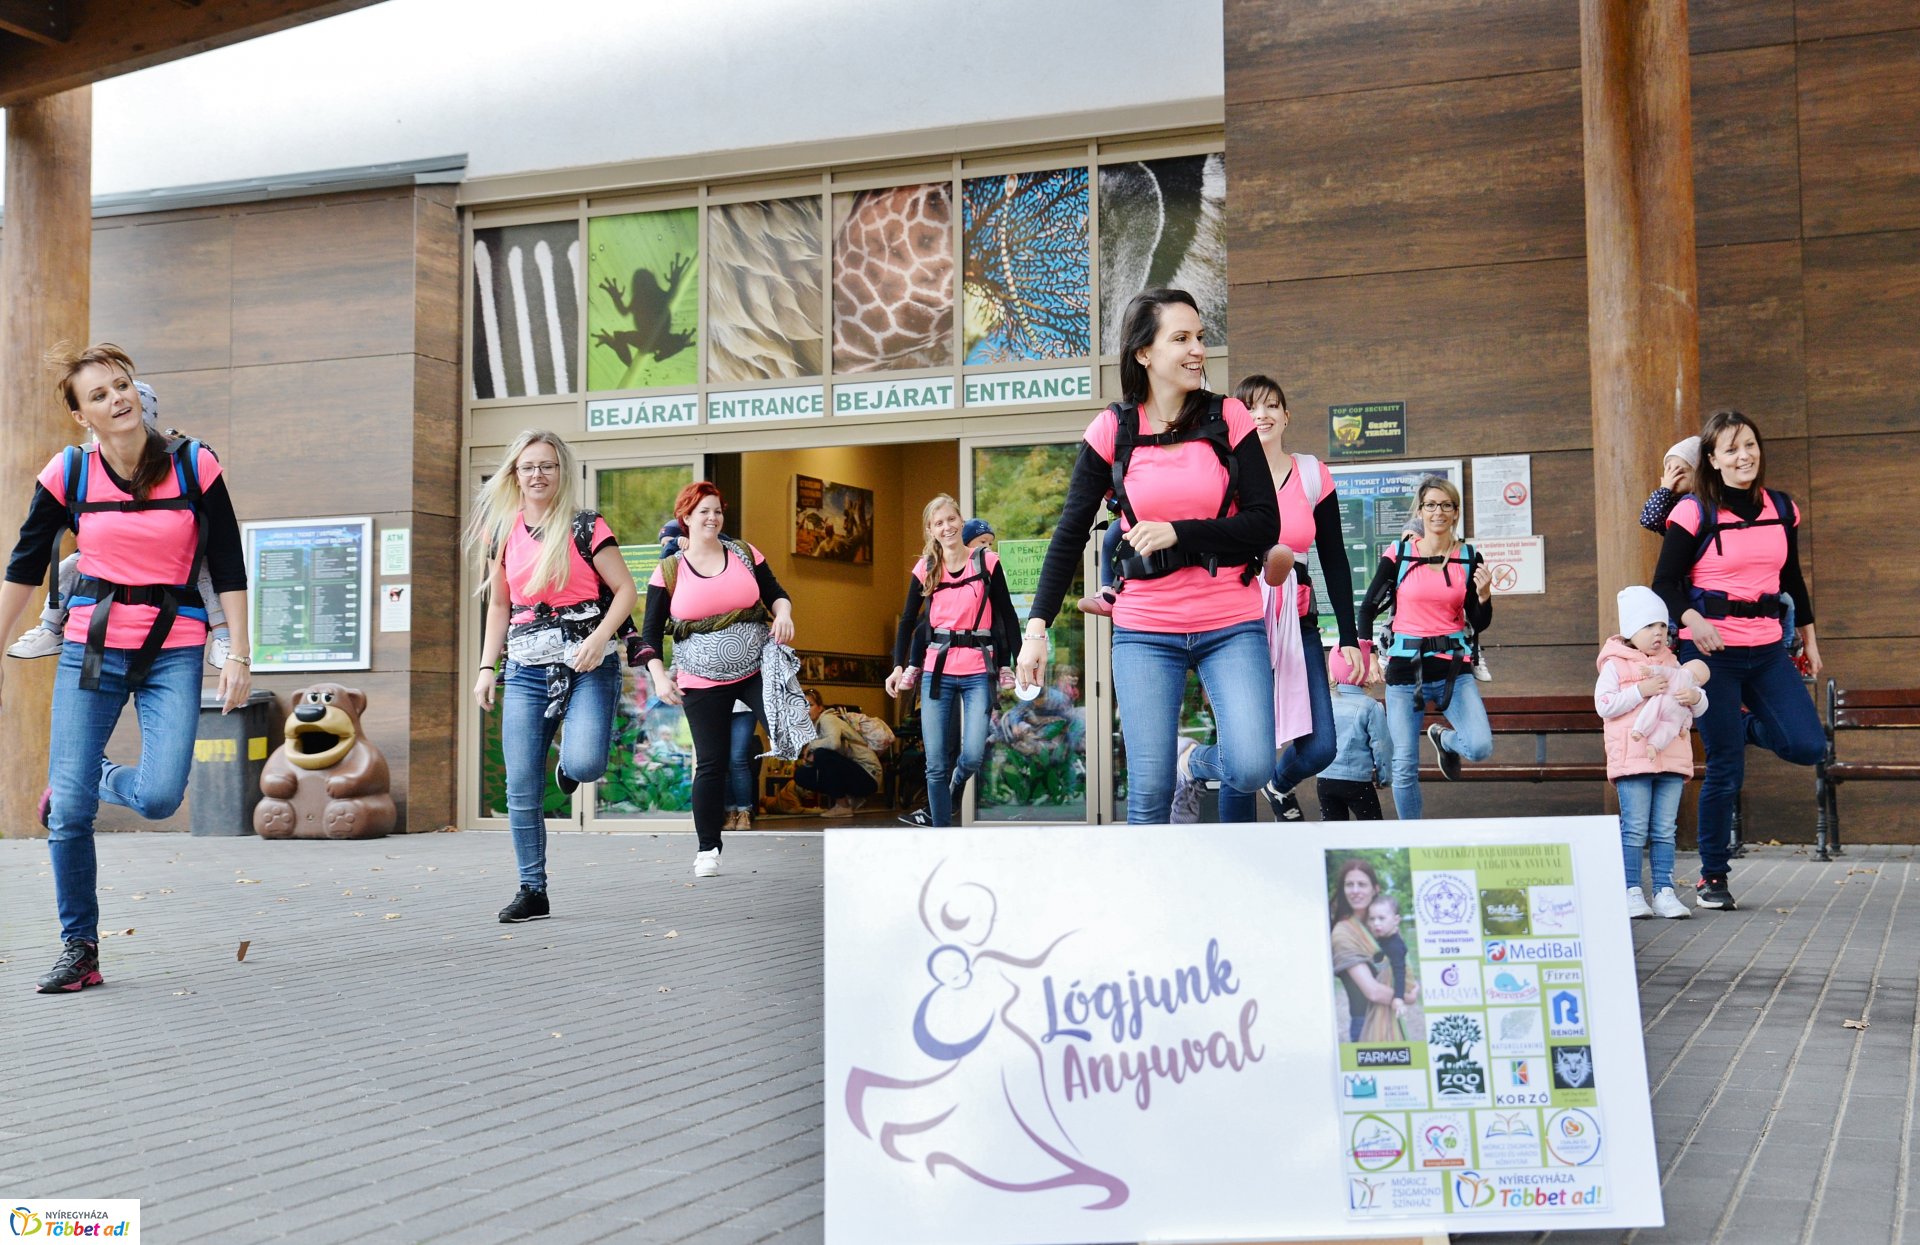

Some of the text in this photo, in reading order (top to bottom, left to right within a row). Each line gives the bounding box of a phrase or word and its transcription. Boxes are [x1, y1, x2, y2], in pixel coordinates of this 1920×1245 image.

[965, 376, 1091, 403] ENTRANCE
[836, 385, 953, 412] BEJÁRAT
[590, 402, 697, 427] BEJÁRAT
[708, 395, 823, 420] ENTRANCE
[1364, 405, 1400, 413] SECURITY
[1007, 569, 1029, 577] CASH
[1012, 578, 1029, 586] ARE
[1510, 942, 1582, 959] MediBall
[1041, 938, 1240, 1043] Lógjunk
[1063, 998, 1265, 1111] Anyuval
[1441, 1074, 1480, 1086] ZOO
[1496, 1093, 1549, 1105] KORZÓ
[1391, 1178, 1427, 1186] MÓRICZ
[1499, 1173, 1575, 1185] NYÍREGYHÁZA
[1392, 1187, 1441, 1197] ZSIGMOND
[1500, 1186, 1602, 1207] Többet ad!
